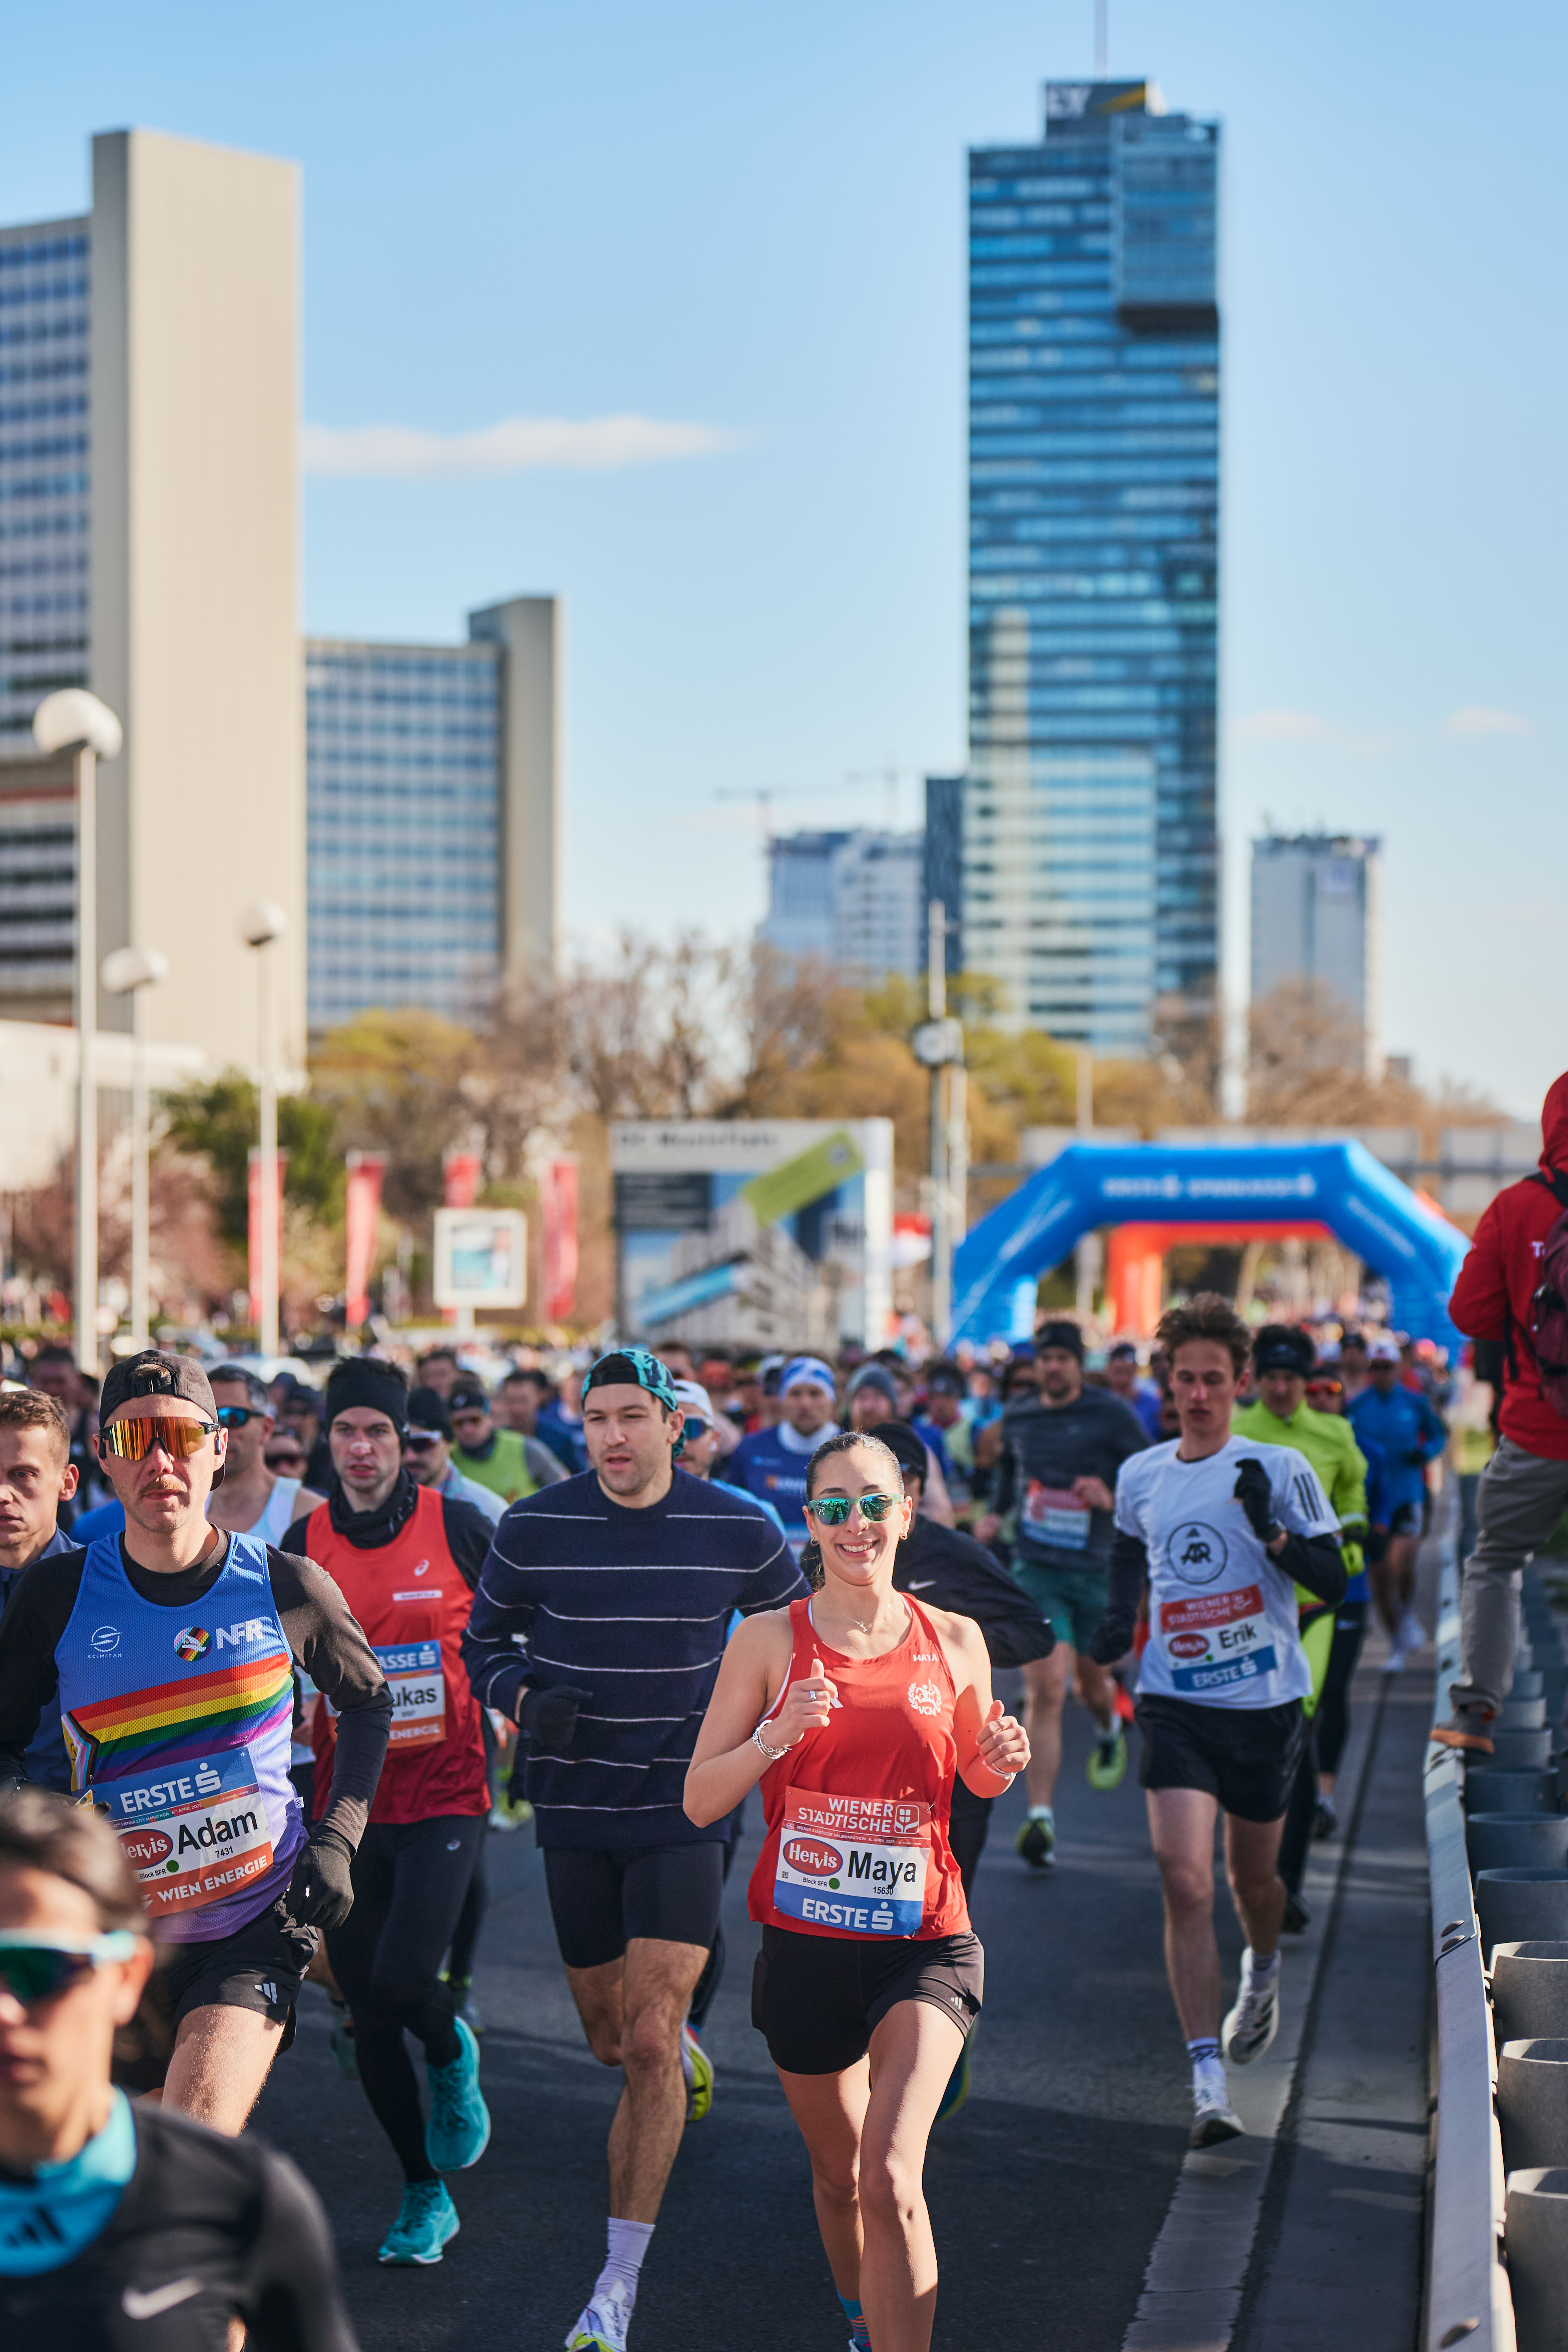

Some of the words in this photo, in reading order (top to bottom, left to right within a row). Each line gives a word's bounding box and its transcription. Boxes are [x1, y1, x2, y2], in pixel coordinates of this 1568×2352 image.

[216, 1619, 264, 1649] NFR
[1219, 1623, 1257, 1649] Erik
[378, 1652, 418, 1670] ASSE
[1192, 1665, 1241, 1688] ERSTE
[392, 1686, 437, 1707] ukas
[918, 1705, 936, 1716] VCM
[120, 1777, 195, 1813] ERSTE
[146, 1812, 169, 1821] MARATHON
[828, 1798, 893, 1817] WIENER
[798, 1807, 892, 1833] STÄDTISCHE
[179, 1811, 258, 1855] Adam
[812, 1828, 833, 1837] STÄDTISCHE
[215, 1846, 233, 1858] 7431
[789, 1842, 837, 1869] Hervis
[140, 1871, 154, 1879] Block
[157, 1881, 202, 1903] WIEN
[204, 1855, 267, 1891] ENERGIE
[848, 1850, 916, 1889] Maya
[803, 1877, 817, 1885] Block
[873, 1886, 894, 1895] 15630
[802, 1898, 869, 1928] ERSTE
